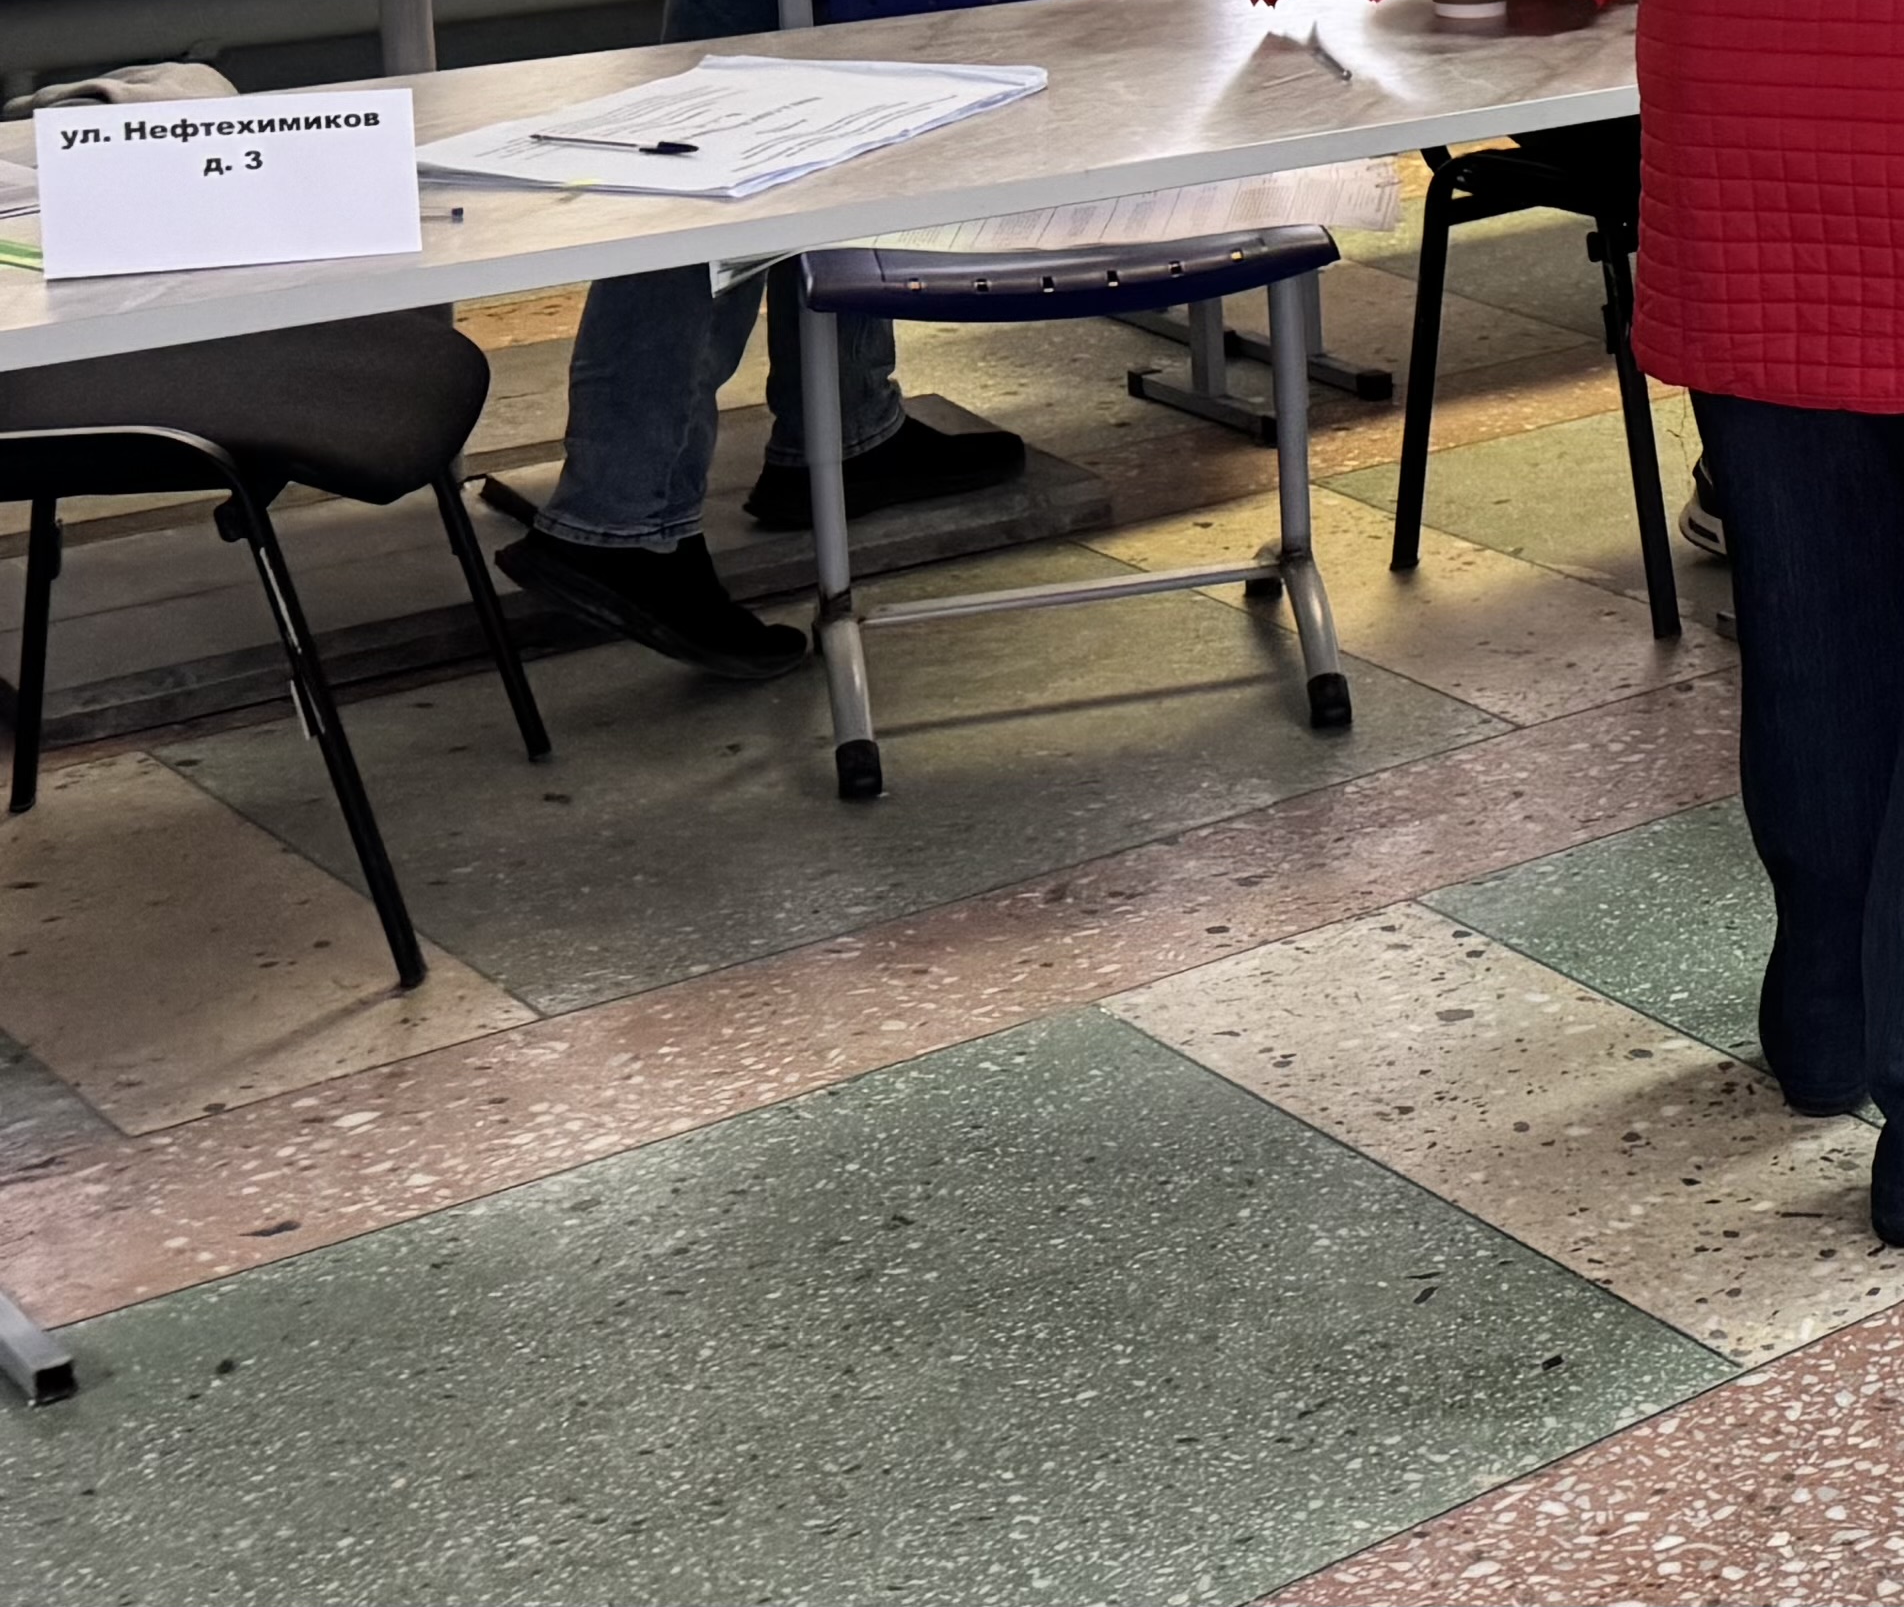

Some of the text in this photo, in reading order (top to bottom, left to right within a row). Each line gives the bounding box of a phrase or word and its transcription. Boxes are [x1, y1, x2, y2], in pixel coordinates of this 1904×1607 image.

[60, 111, 381, 150] ул. Нефтехимиков
[203, 150, 263, 177] д. 3
